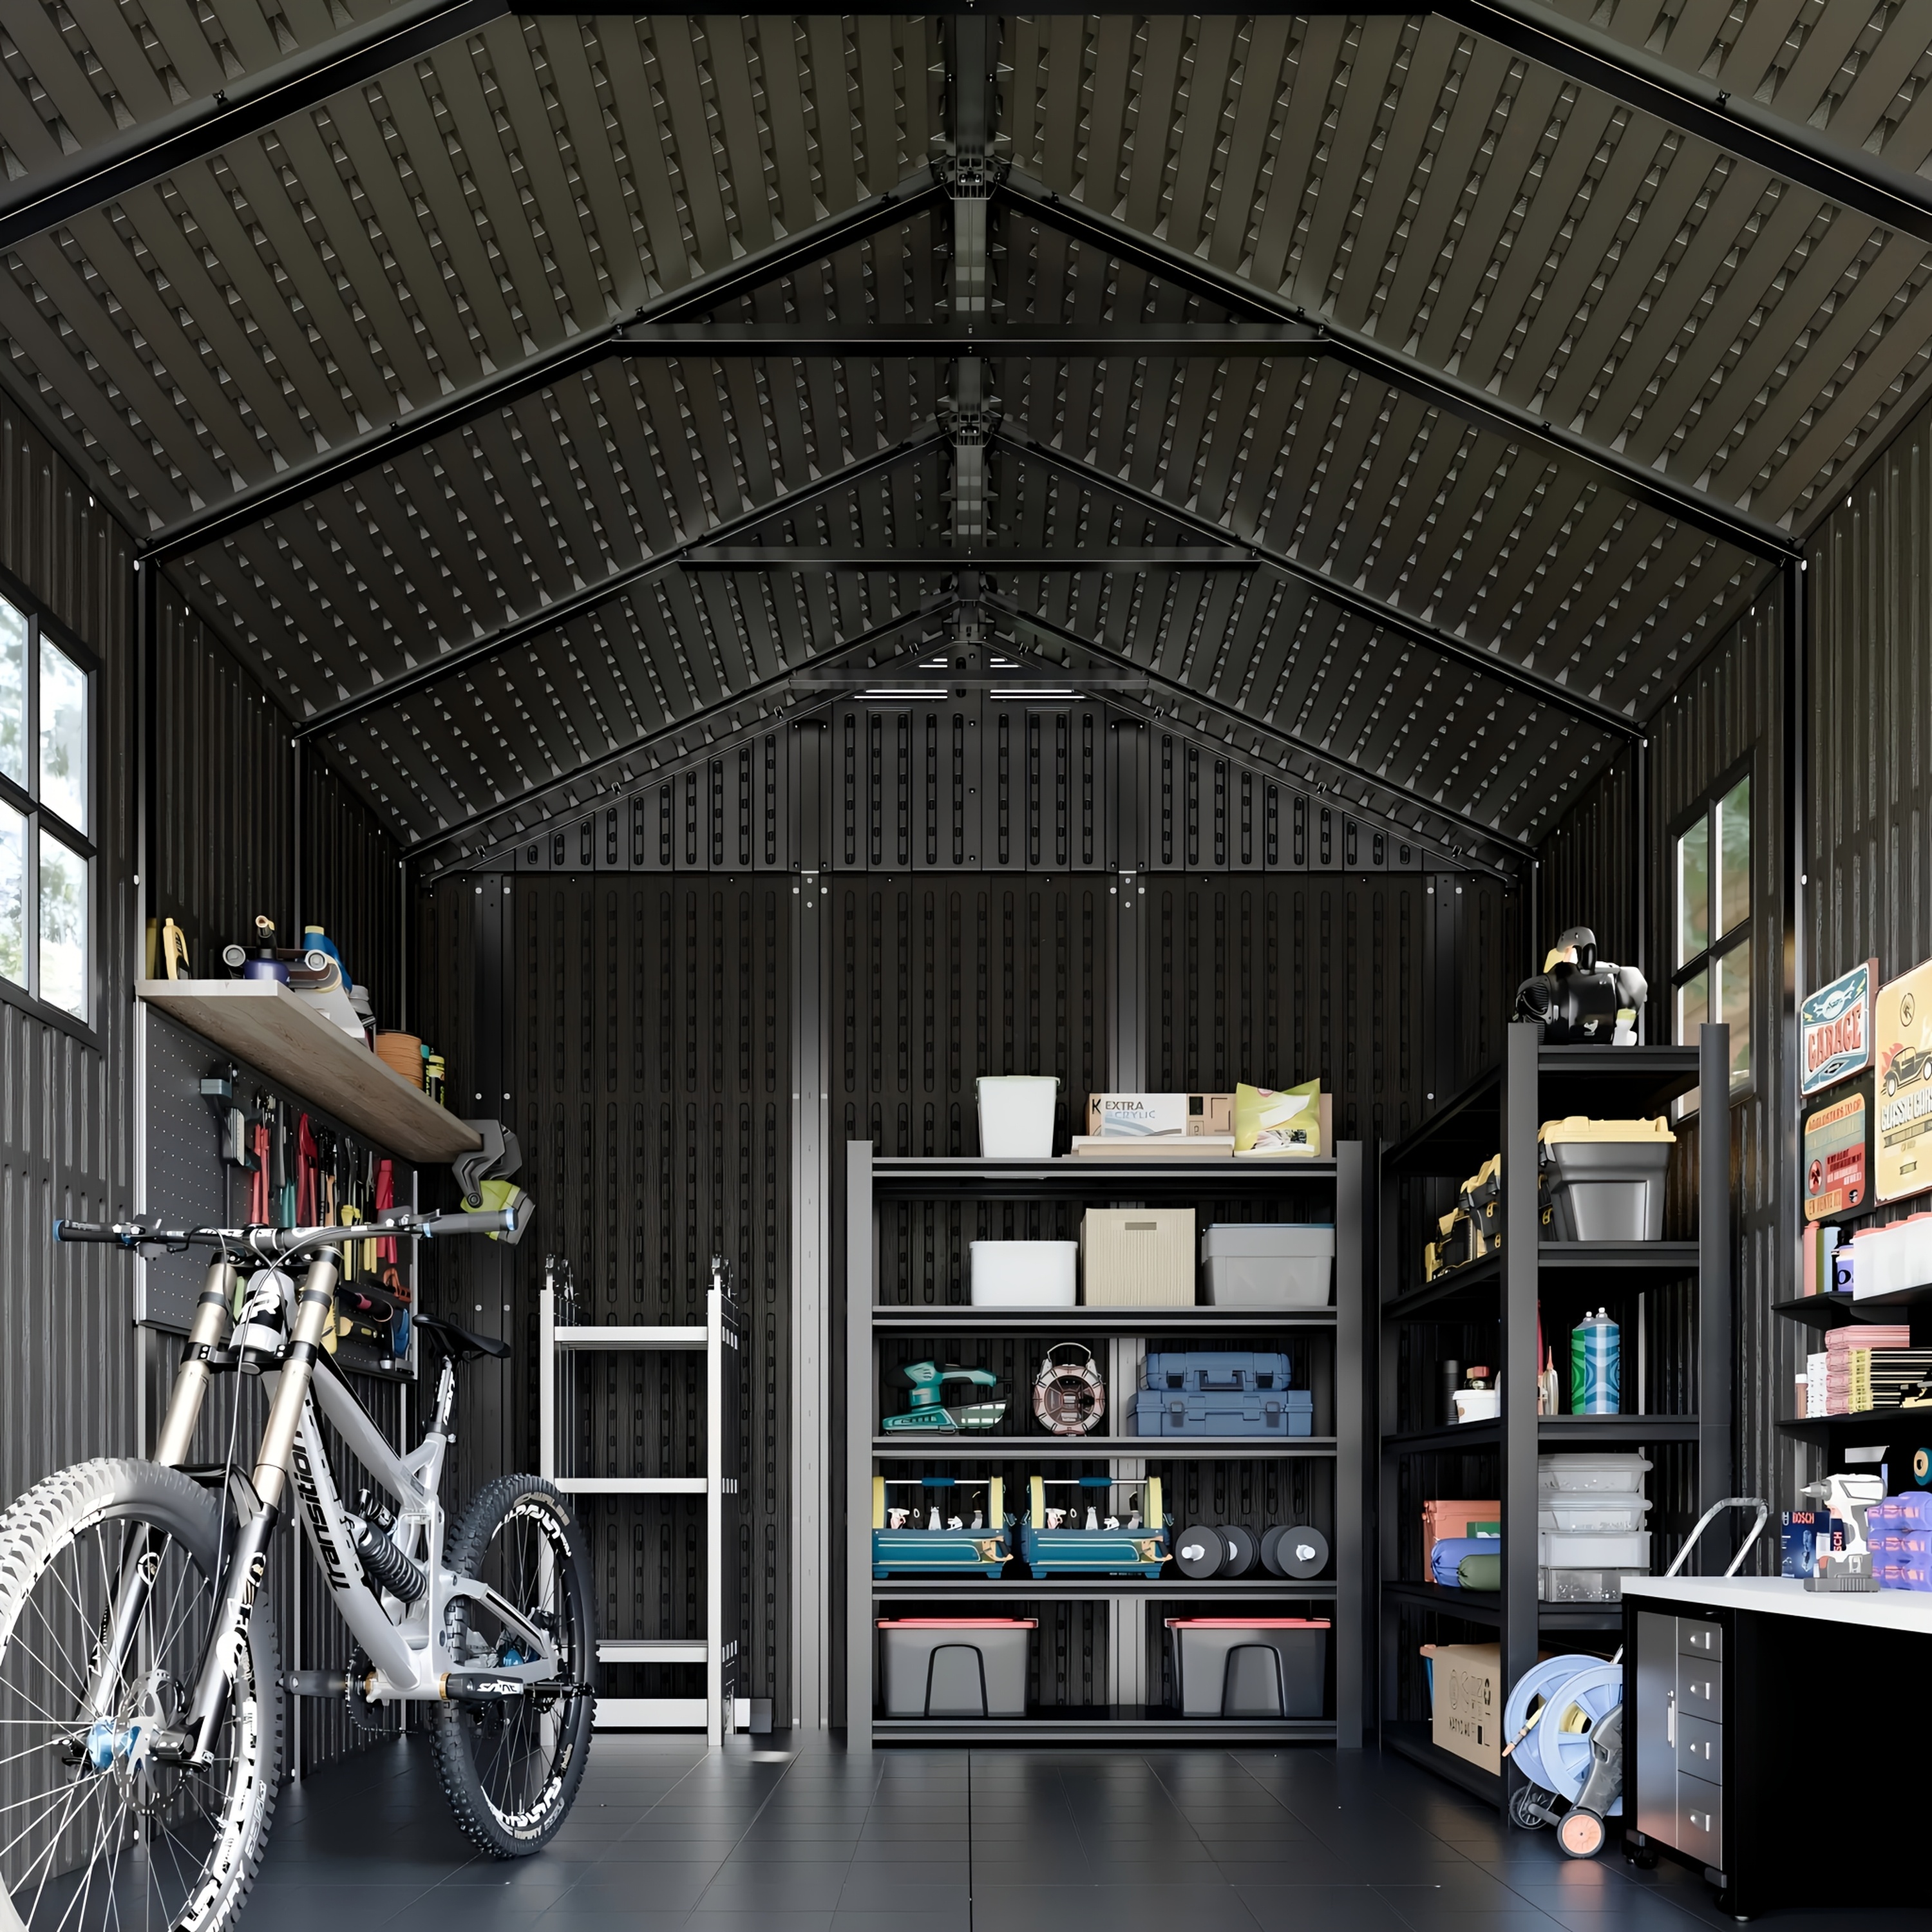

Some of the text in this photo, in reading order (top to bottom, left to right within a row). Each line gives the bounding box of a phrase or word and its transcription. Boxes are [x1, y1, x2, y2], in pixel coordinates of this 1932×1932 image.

[1808, 1002, 1862, 1073] GARAGE
[1105, 1101, 1144, 1111] EXTRA
[1881, 1094, 1913, 1132] CLASSIC
